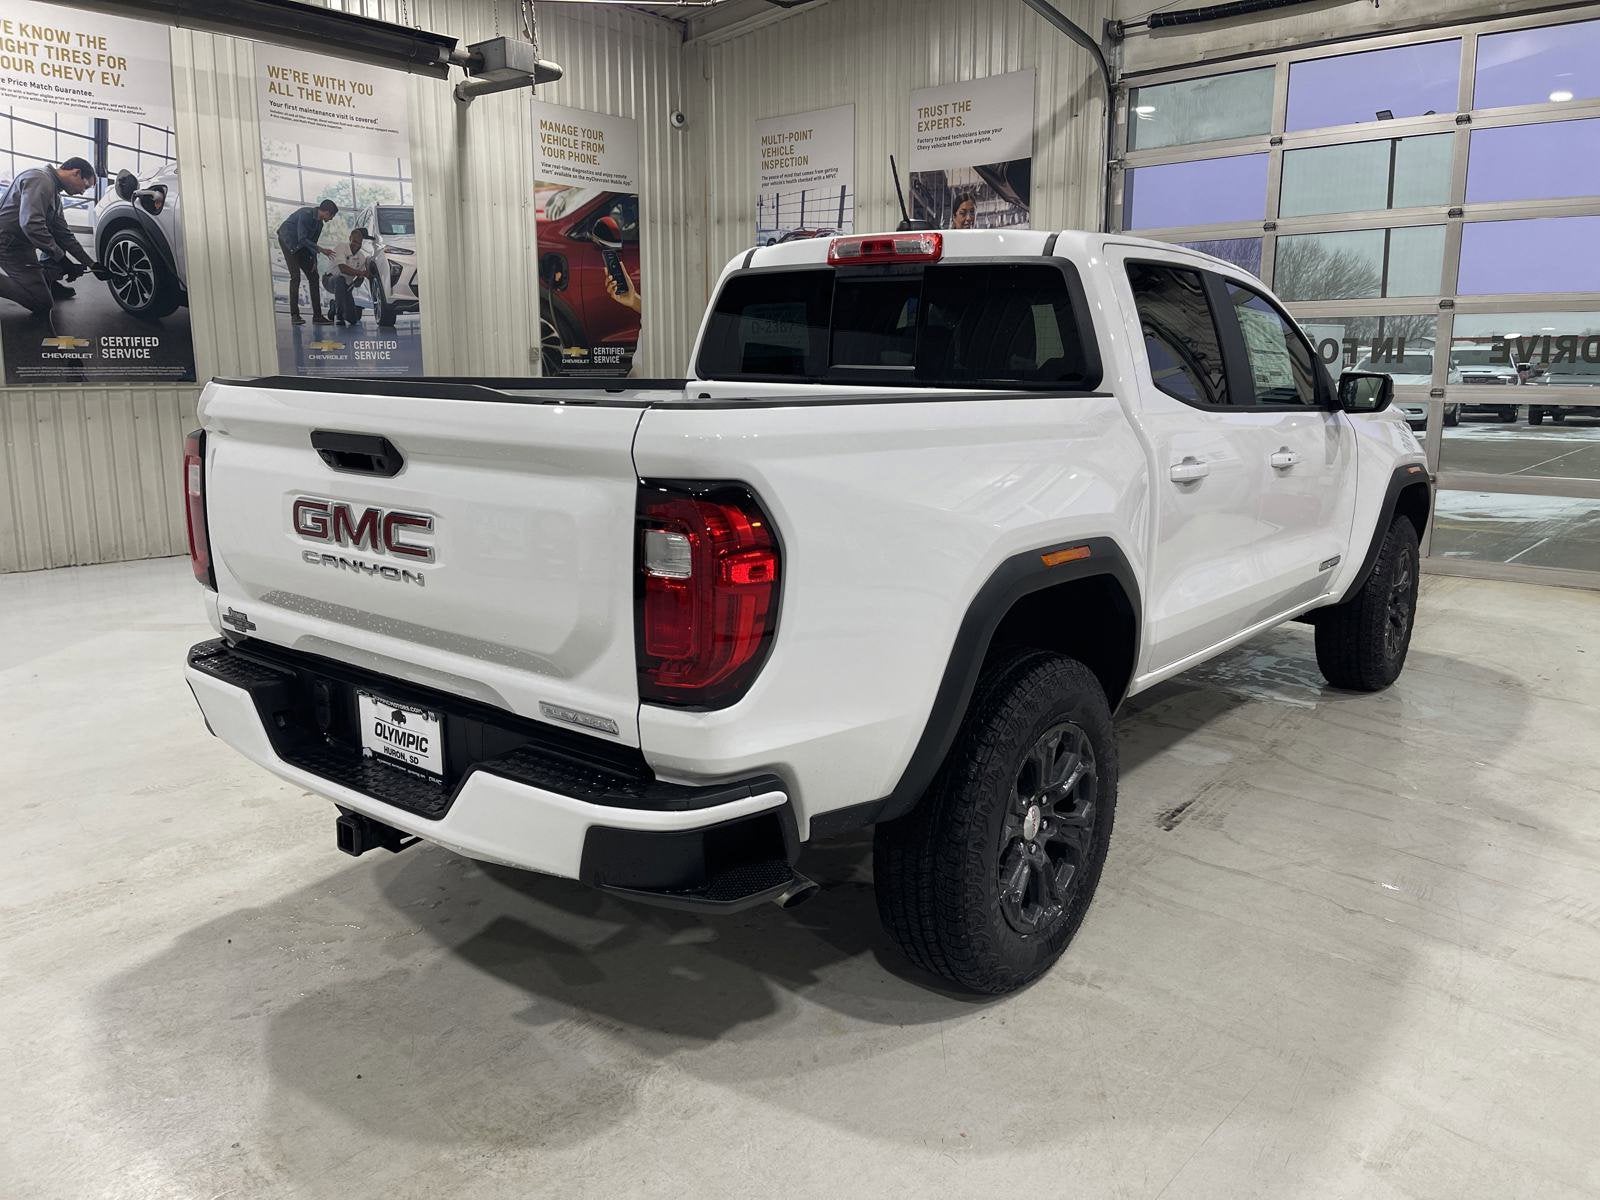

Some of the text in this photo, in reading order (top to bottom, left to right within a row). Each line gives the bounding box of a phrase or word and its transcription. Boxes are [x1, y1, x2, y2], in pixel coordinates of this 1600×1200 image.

[0, 20, 107, 51] E KNOW THE
[0, 37, 127, 71] IGHT TIRES FOR
[0, 55, 125, 88] OUR CHEVY EV.
[267, 65, 374, 96] WE'RE WITH YOU
[8, 77, 28, 87] Price
[30, 81, 53, 91] Match
[55, 85, 95, 98] Guarantee.
[269, 81, 356, 108] ALL THE WAY.
[269, 99, 283, 108] Your
[284, 103, 298, 111] first
[299, 107, 335, 118] maintenance
[917, 100, 972, 119] TRUST THE
[540, 119, 604, 141] MANAGE YOUR
[917, 116, 965, 132] EXPERTS.
[540, 132, 605, 154] VEHICLE FROM
[761, 129, 814, 146] MULTI-POINT
[917, 136, 934, 144] Factory
[951, 131, 978, 139] technicians
[540, 145, 600, 166] YOUR PHONE.
[761, 145, 795, 158] VEHICLE
[761, 155, 809, 170] INSPECTION
[100, 336, 160, 347] CERTIFIED
[353, 340, 397, 350] CERTIFIED
[593, 347, 625, 355] CERTIFIED
[101, 348, 151, 359] SERVICE
[354, 351, 391, 360] SERVICE
[593, 356, 620, 364] SERVICE
[293, 496, 436, 564] GMC
[302, 550, 426, 587] CANYON
[374, 721, 429, 753] OLYMPIC
[383, 746, 419, 765] HURON, SD
